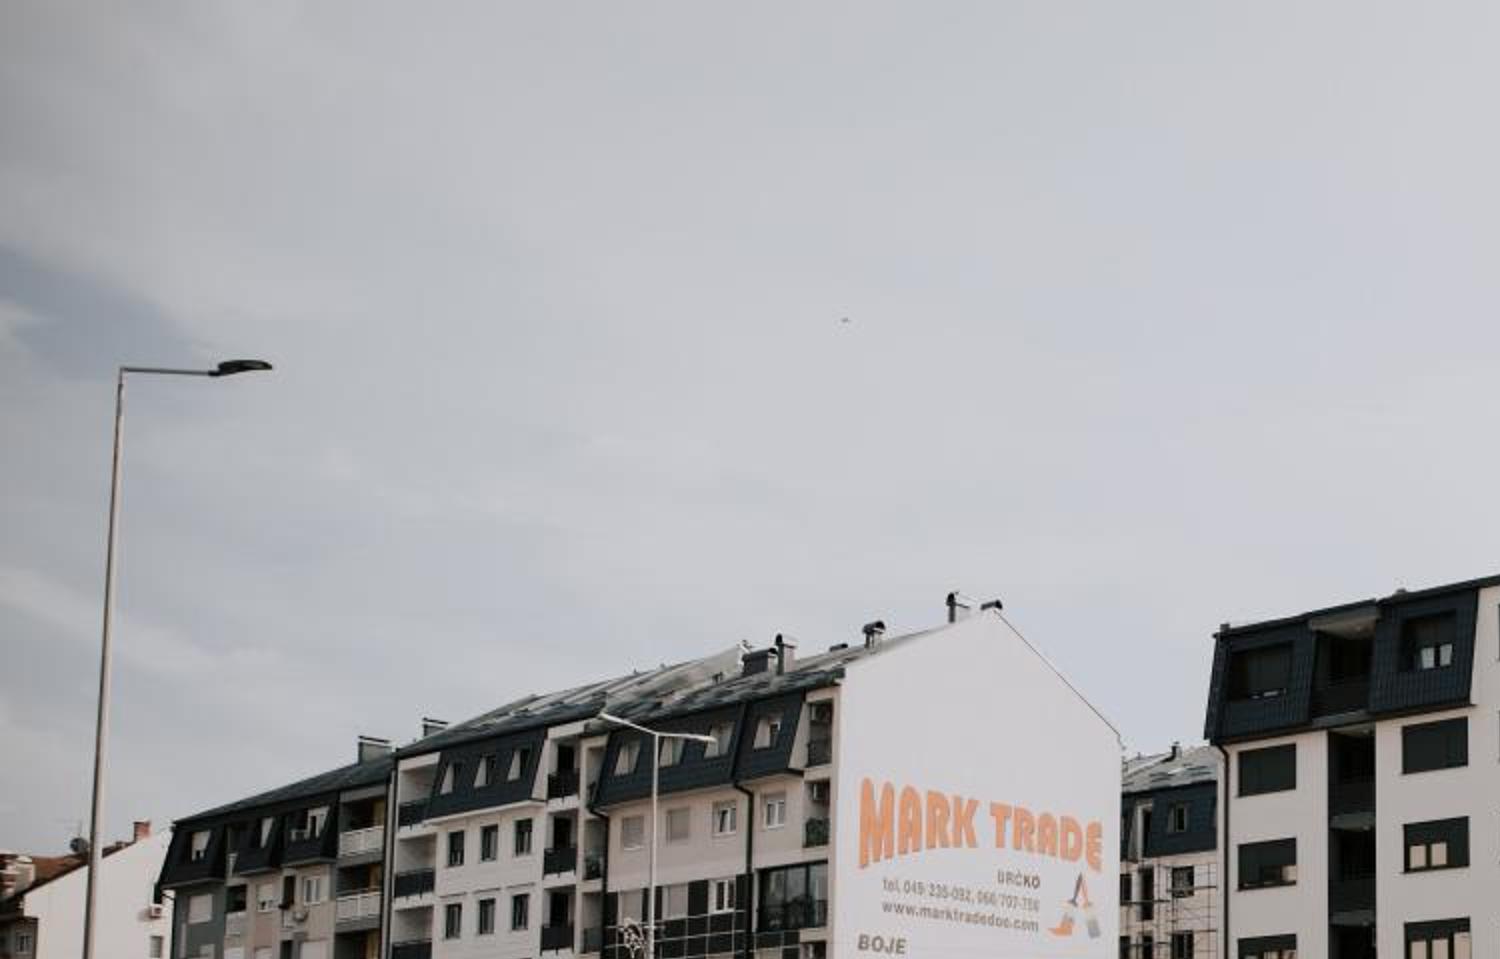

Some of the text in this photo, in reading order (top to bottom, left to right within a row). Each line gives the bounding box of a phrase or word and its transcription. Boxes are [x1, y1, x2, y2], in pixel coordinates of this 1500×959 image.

[858, 777, 1103, 873] MARK TRADE
[857, 934, 906, 954] BOJE
